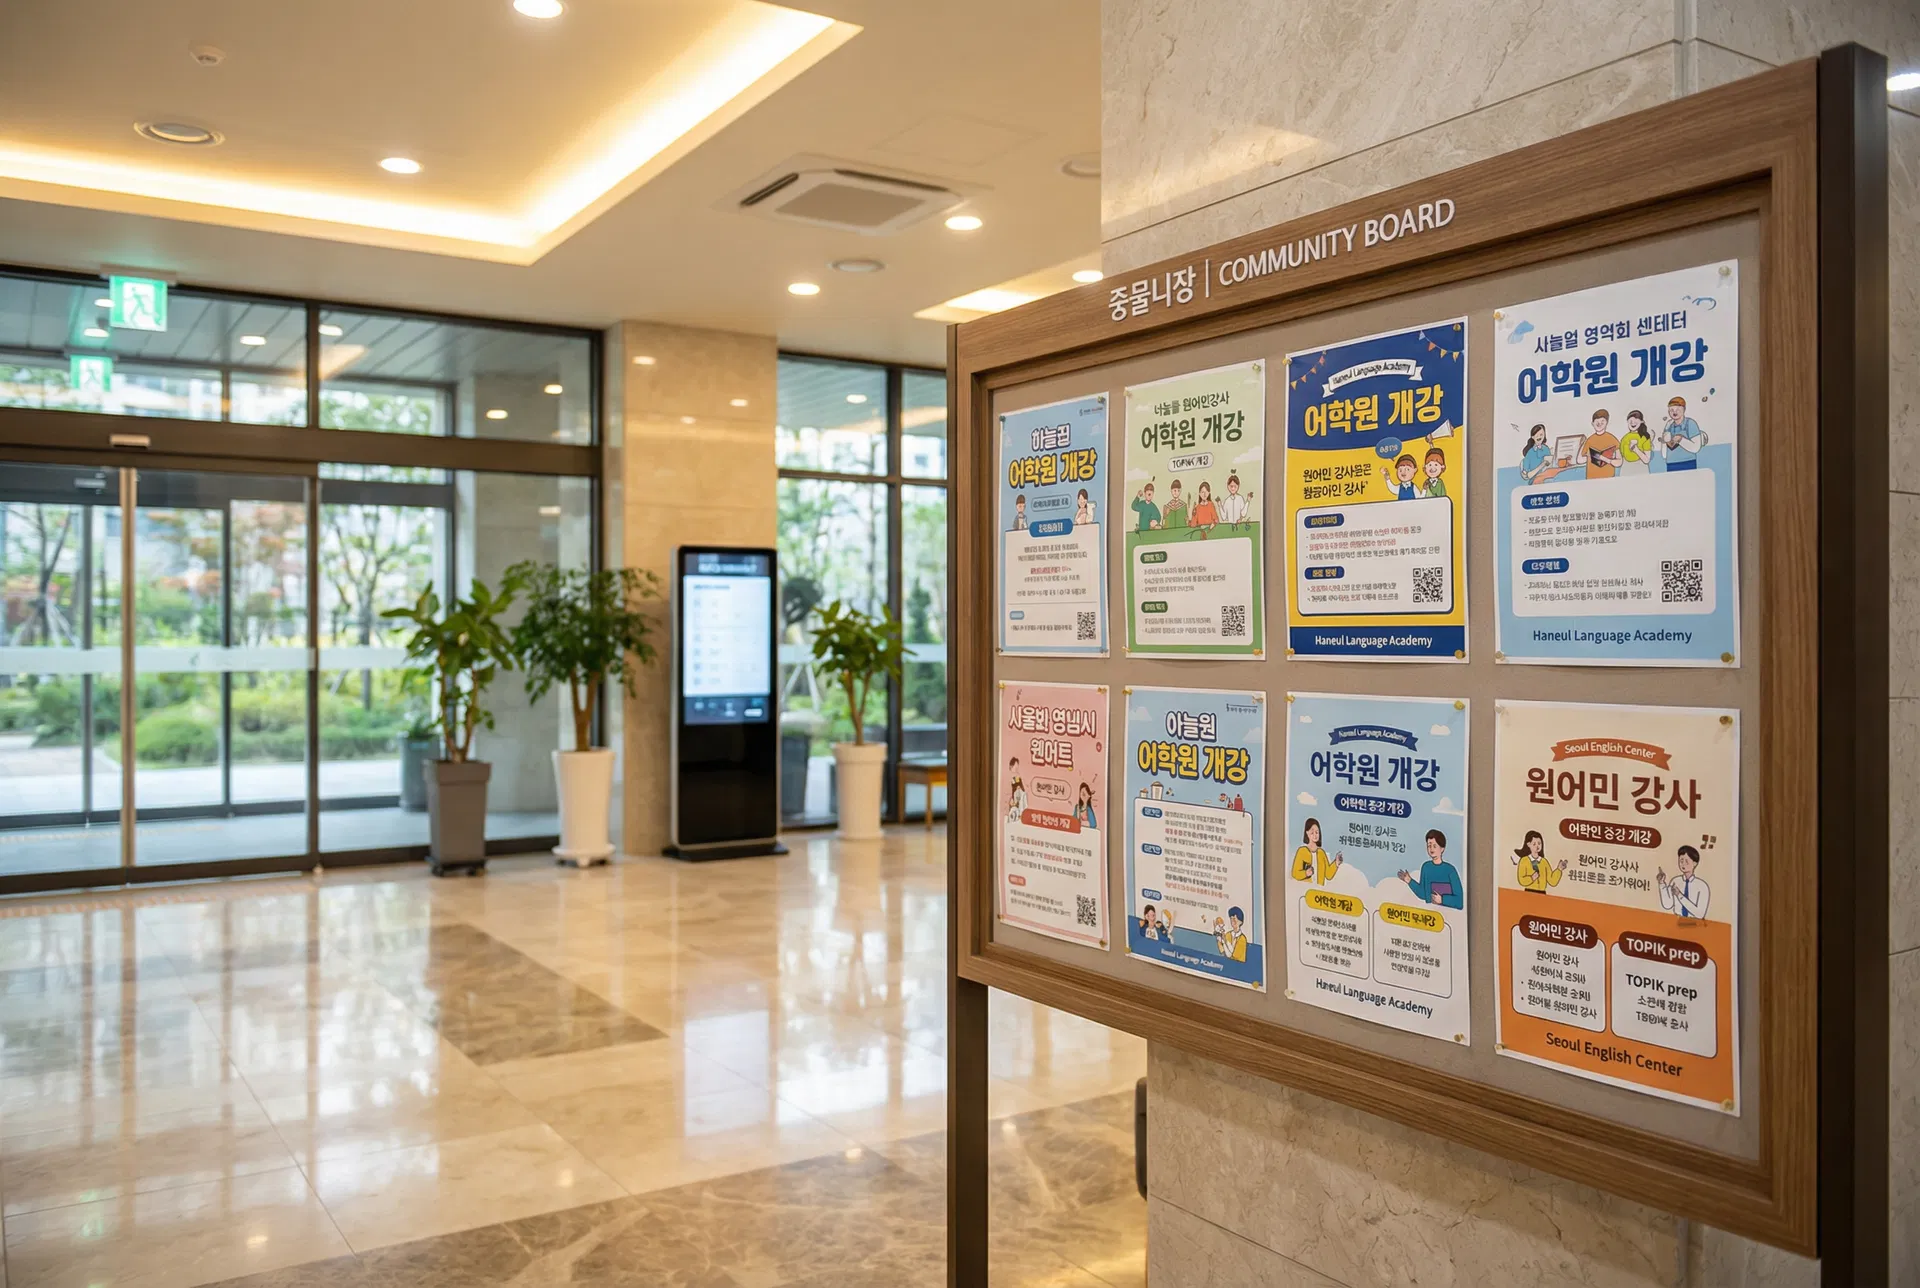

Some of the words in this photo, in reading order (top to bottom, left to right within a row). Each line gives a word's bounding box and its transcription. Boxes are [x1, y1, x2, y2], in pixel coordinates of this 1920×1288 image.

[1108, 265, 1196, 321] 중물니장
[1219, 224, 1358, 286] COMMUNITY
[1364, 198, 1456, 247] BOARD
[1518, 351, 1619, 404] 어학원
[1630, 337, 1709, 388] 개강
[1304, 394, 1379, 437] 어학원
[1387, 384, 1444, 425] 개강
[1141, 417, 1196, 453] 어학원
[1202, 410, 1245, 443] 개강
[1009, 453, 1057, 489] 어학원
[1060, 447, 1098, 482] 개강
[1315, 635, 1344, 646] Haneul
[1346, 635, 1388, 648] Language
[1389, 634, 1433, 649] Academy
[1533, 630, 1571, 641] Haneul
[1574, 630, 1631, 644] Language
[1633, 629, 1693, 644] Academy
[1138, 740, 1200, 780] 어학원
[1202, 745, 1251, 785] 개강
[1564, 742, 1589, 754] Seoul
[1624, 744, 1657, 759] Center
[1310, 751, 1380, 786] 어학원
[1388, 756, 1441, 792] 개강
[1526, 767, 1620, 811] 원어민
[1630, 775, 1702, 819] 강사
[1528, 920, 1562, 938] 원어민
[1564, 926, 1589, 944] 강사
[1625, 937, 1666, 957] TOPIK
[1668, 947, 1701, 965] prep
[1343, 985, 1386, 1007] Language
[1388, 997, 1433, 1019] Academy
[1625, 973, 1666, 993] TOPIK
[1667, 982, 1698, 1001] prep
[1545, 1032, 1581, 1053] Seoul
[1584, 1042, 1632, 1065] English
[1635, 1054, 1684, 1077] Center
